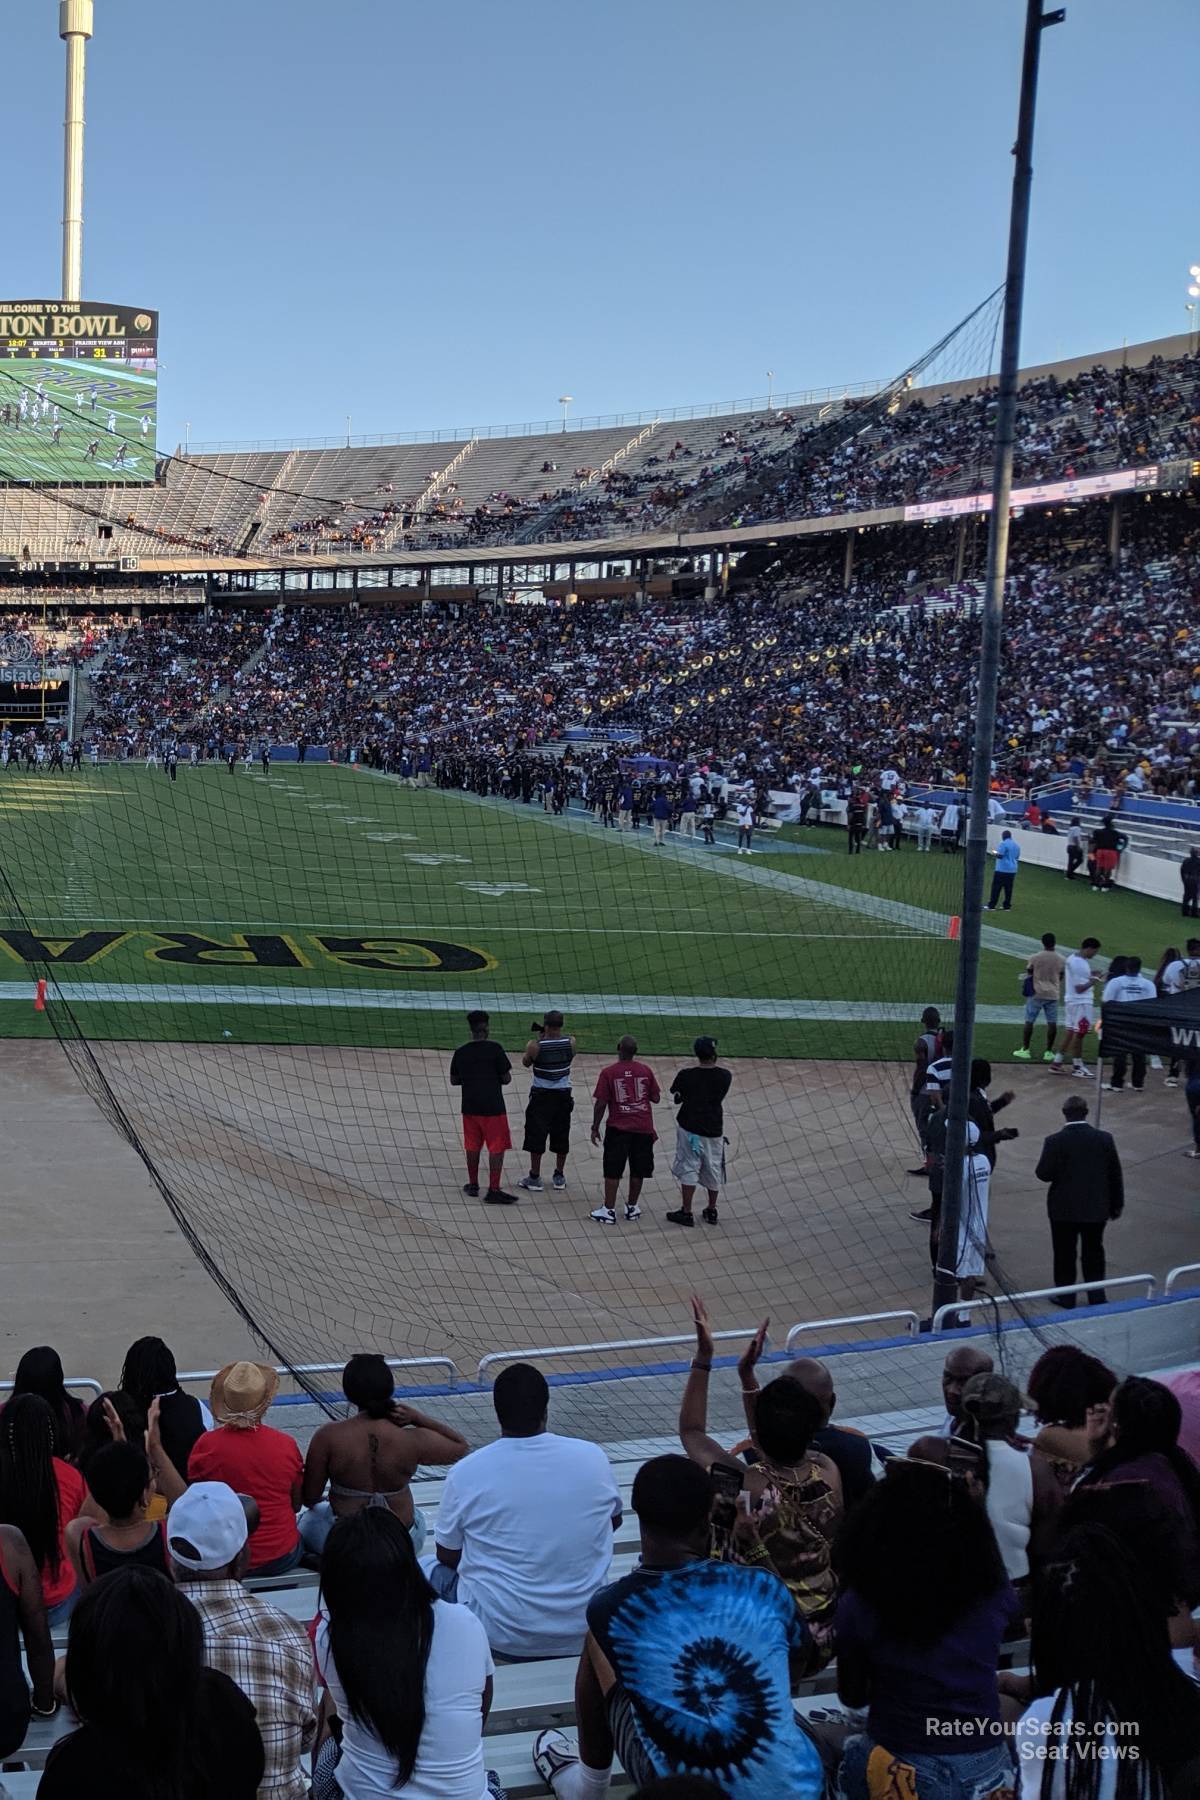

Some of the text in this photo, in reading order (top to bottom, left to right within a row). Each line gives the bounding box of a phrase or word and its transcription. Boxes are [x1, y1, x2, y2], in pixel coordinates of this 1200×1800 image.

[45, 304, 59, 313] TO
[61, 304, 80, 313] THE
[51, 315, 126, 336] BOWL
[93, 348, 107, 358] 31
[126, 558, 137, 570] 10
[1170, 1026, 1200, 1047] W
